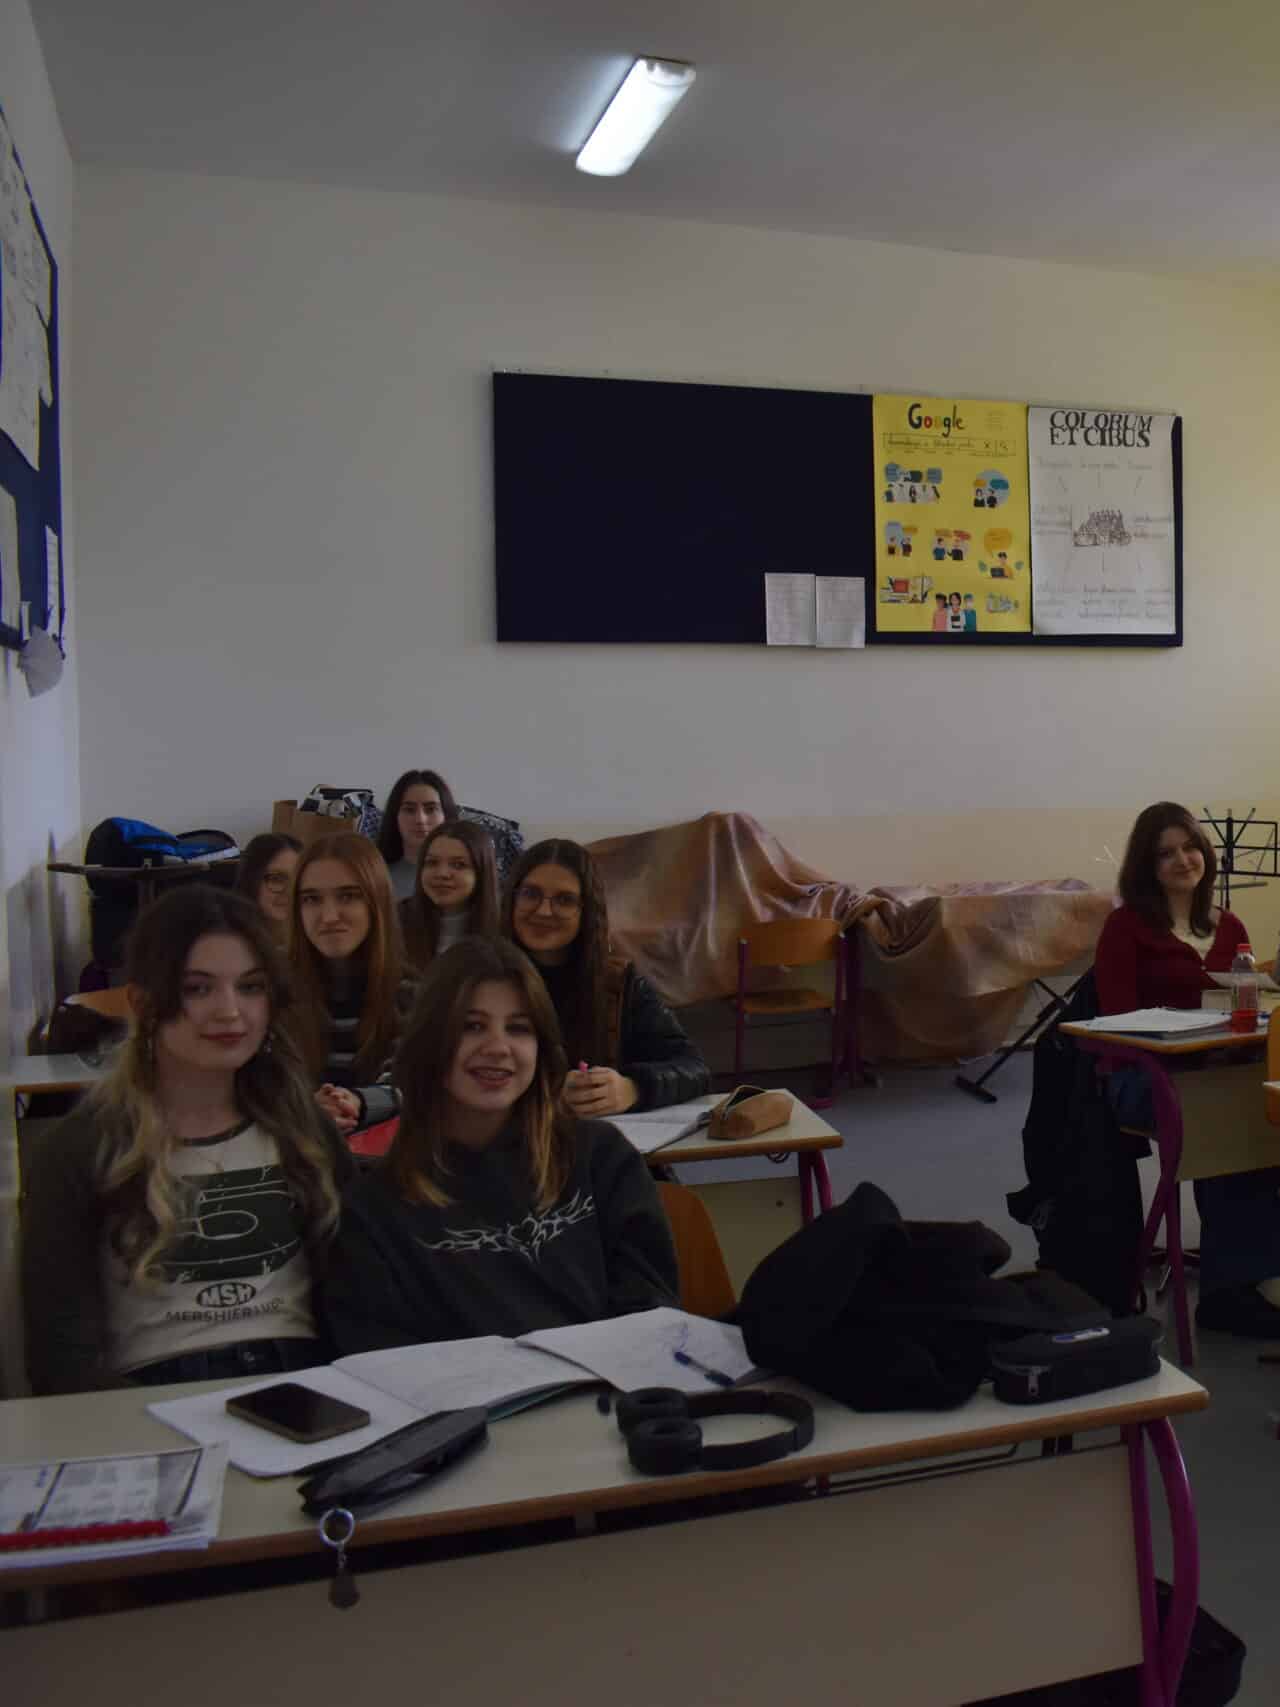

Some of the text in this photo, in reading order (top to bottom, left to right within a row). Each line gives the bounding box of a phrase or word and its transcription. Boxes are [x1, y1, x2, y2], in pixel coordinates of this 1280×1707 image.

[908, 403, 966, 438] Google
[1049, 410, 1152, 433] COLORUM
[1049, 426, 1150, 447] ET CIBUS
